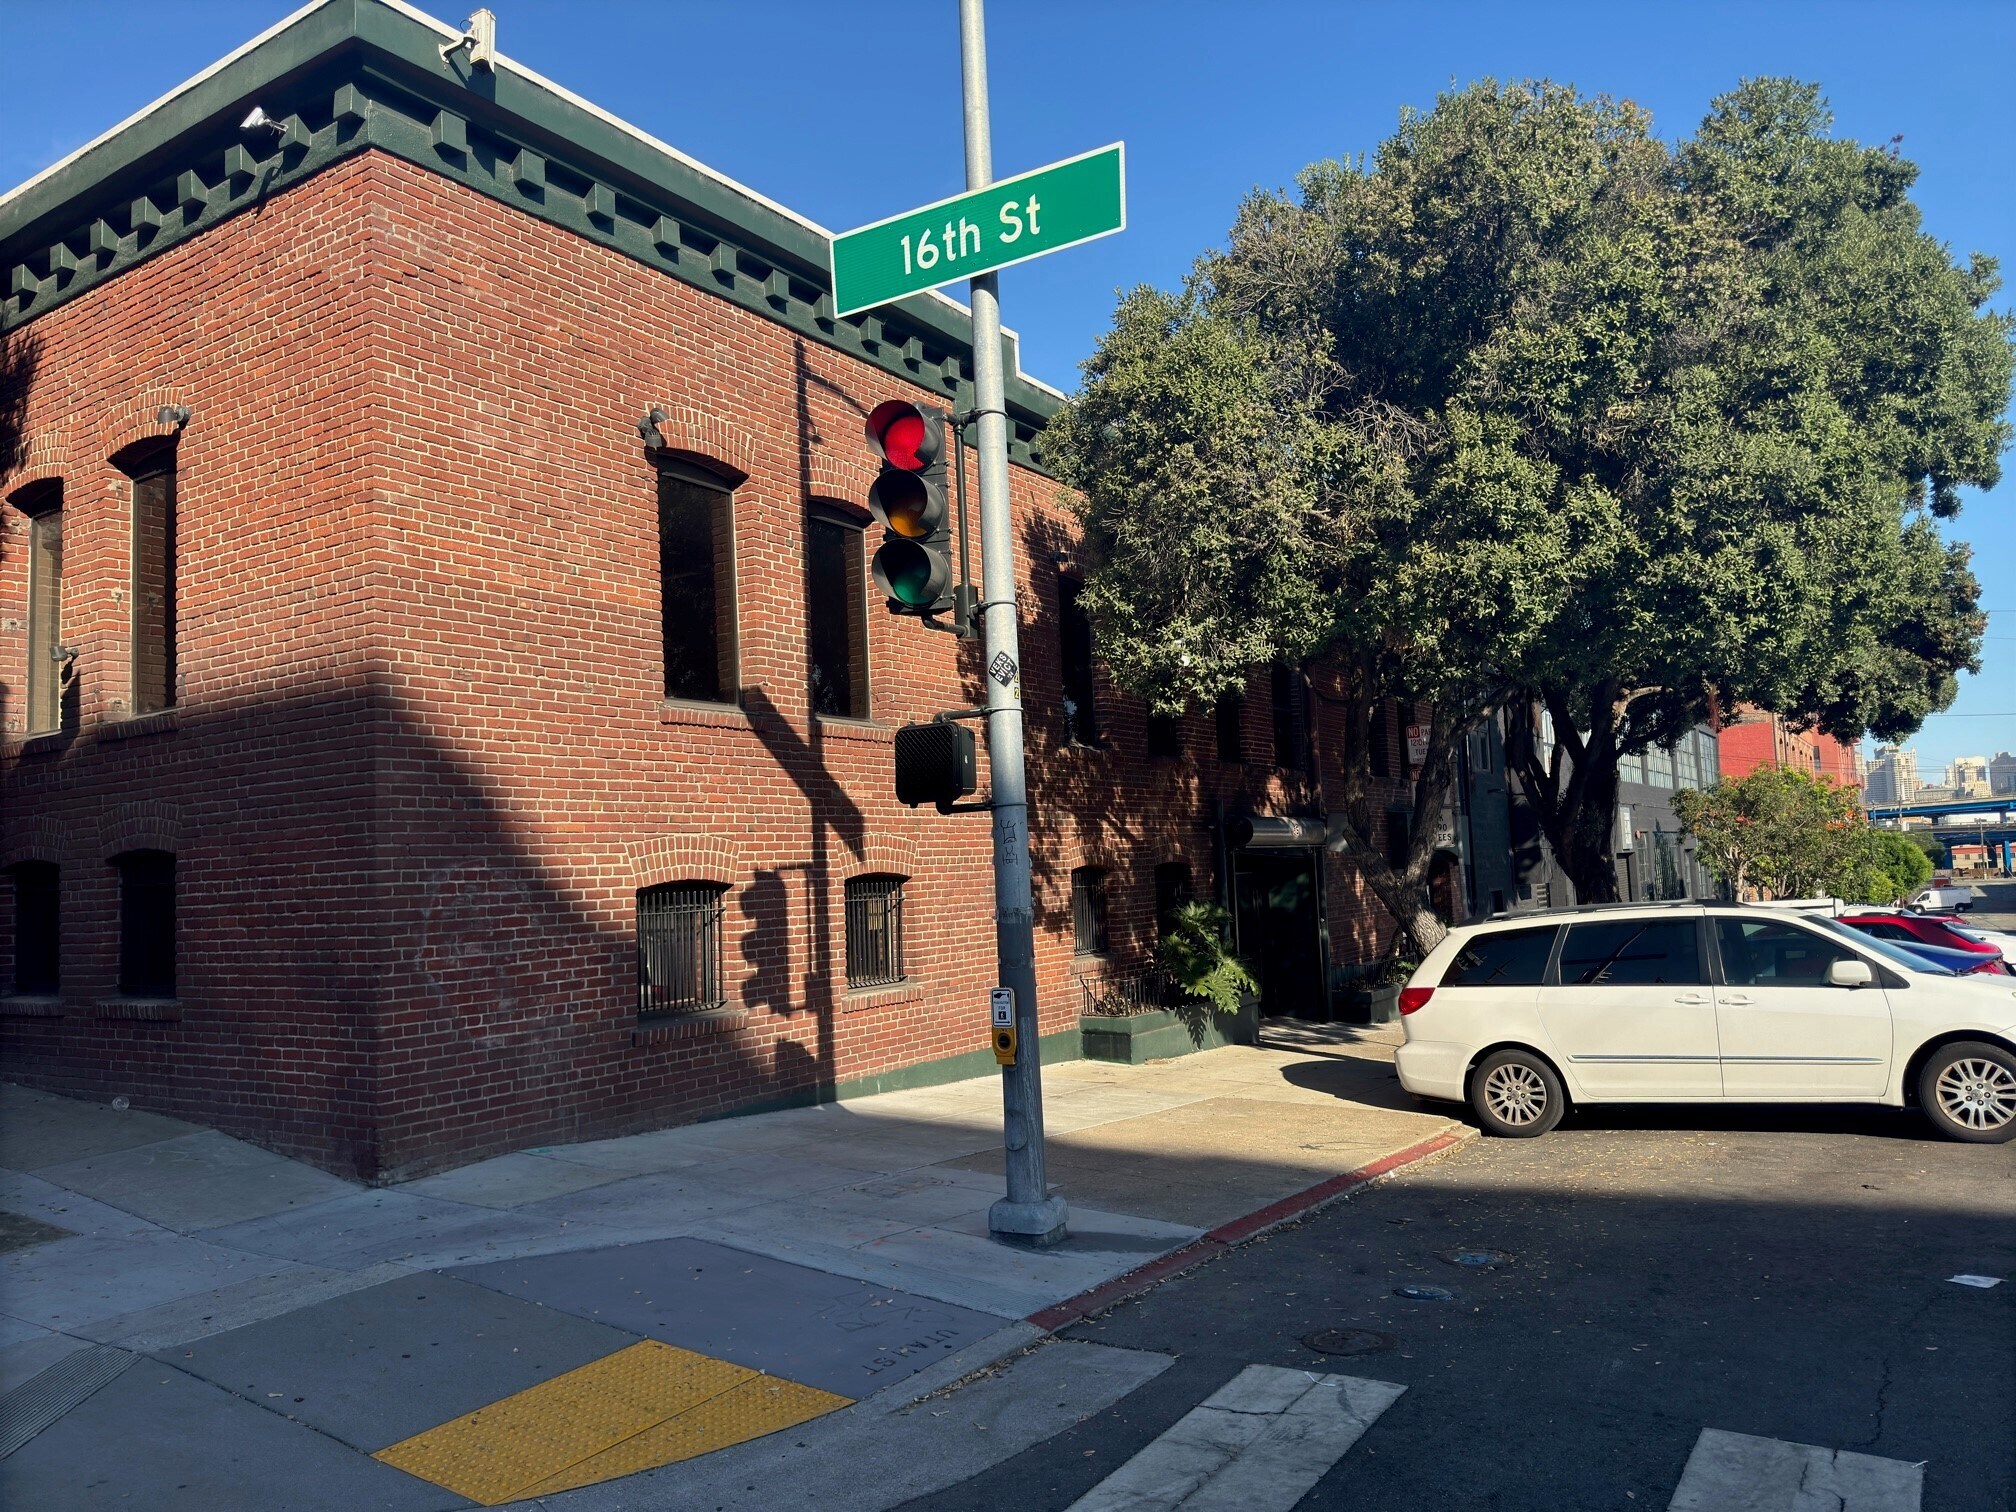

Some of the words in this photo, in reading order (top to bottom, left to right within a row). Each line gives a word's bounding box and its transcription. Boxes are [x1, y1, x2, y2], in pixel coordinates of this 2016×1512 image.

[900, 216, 981, 275] 16th
[999, 193, 1041, 244] St
[989, 653, 1007, 674] VEKS
[995, 659, 1014, 682] EVICT
[1408, 727, 1419, 738] NO
[1438, 833, 1452, 841] EES
